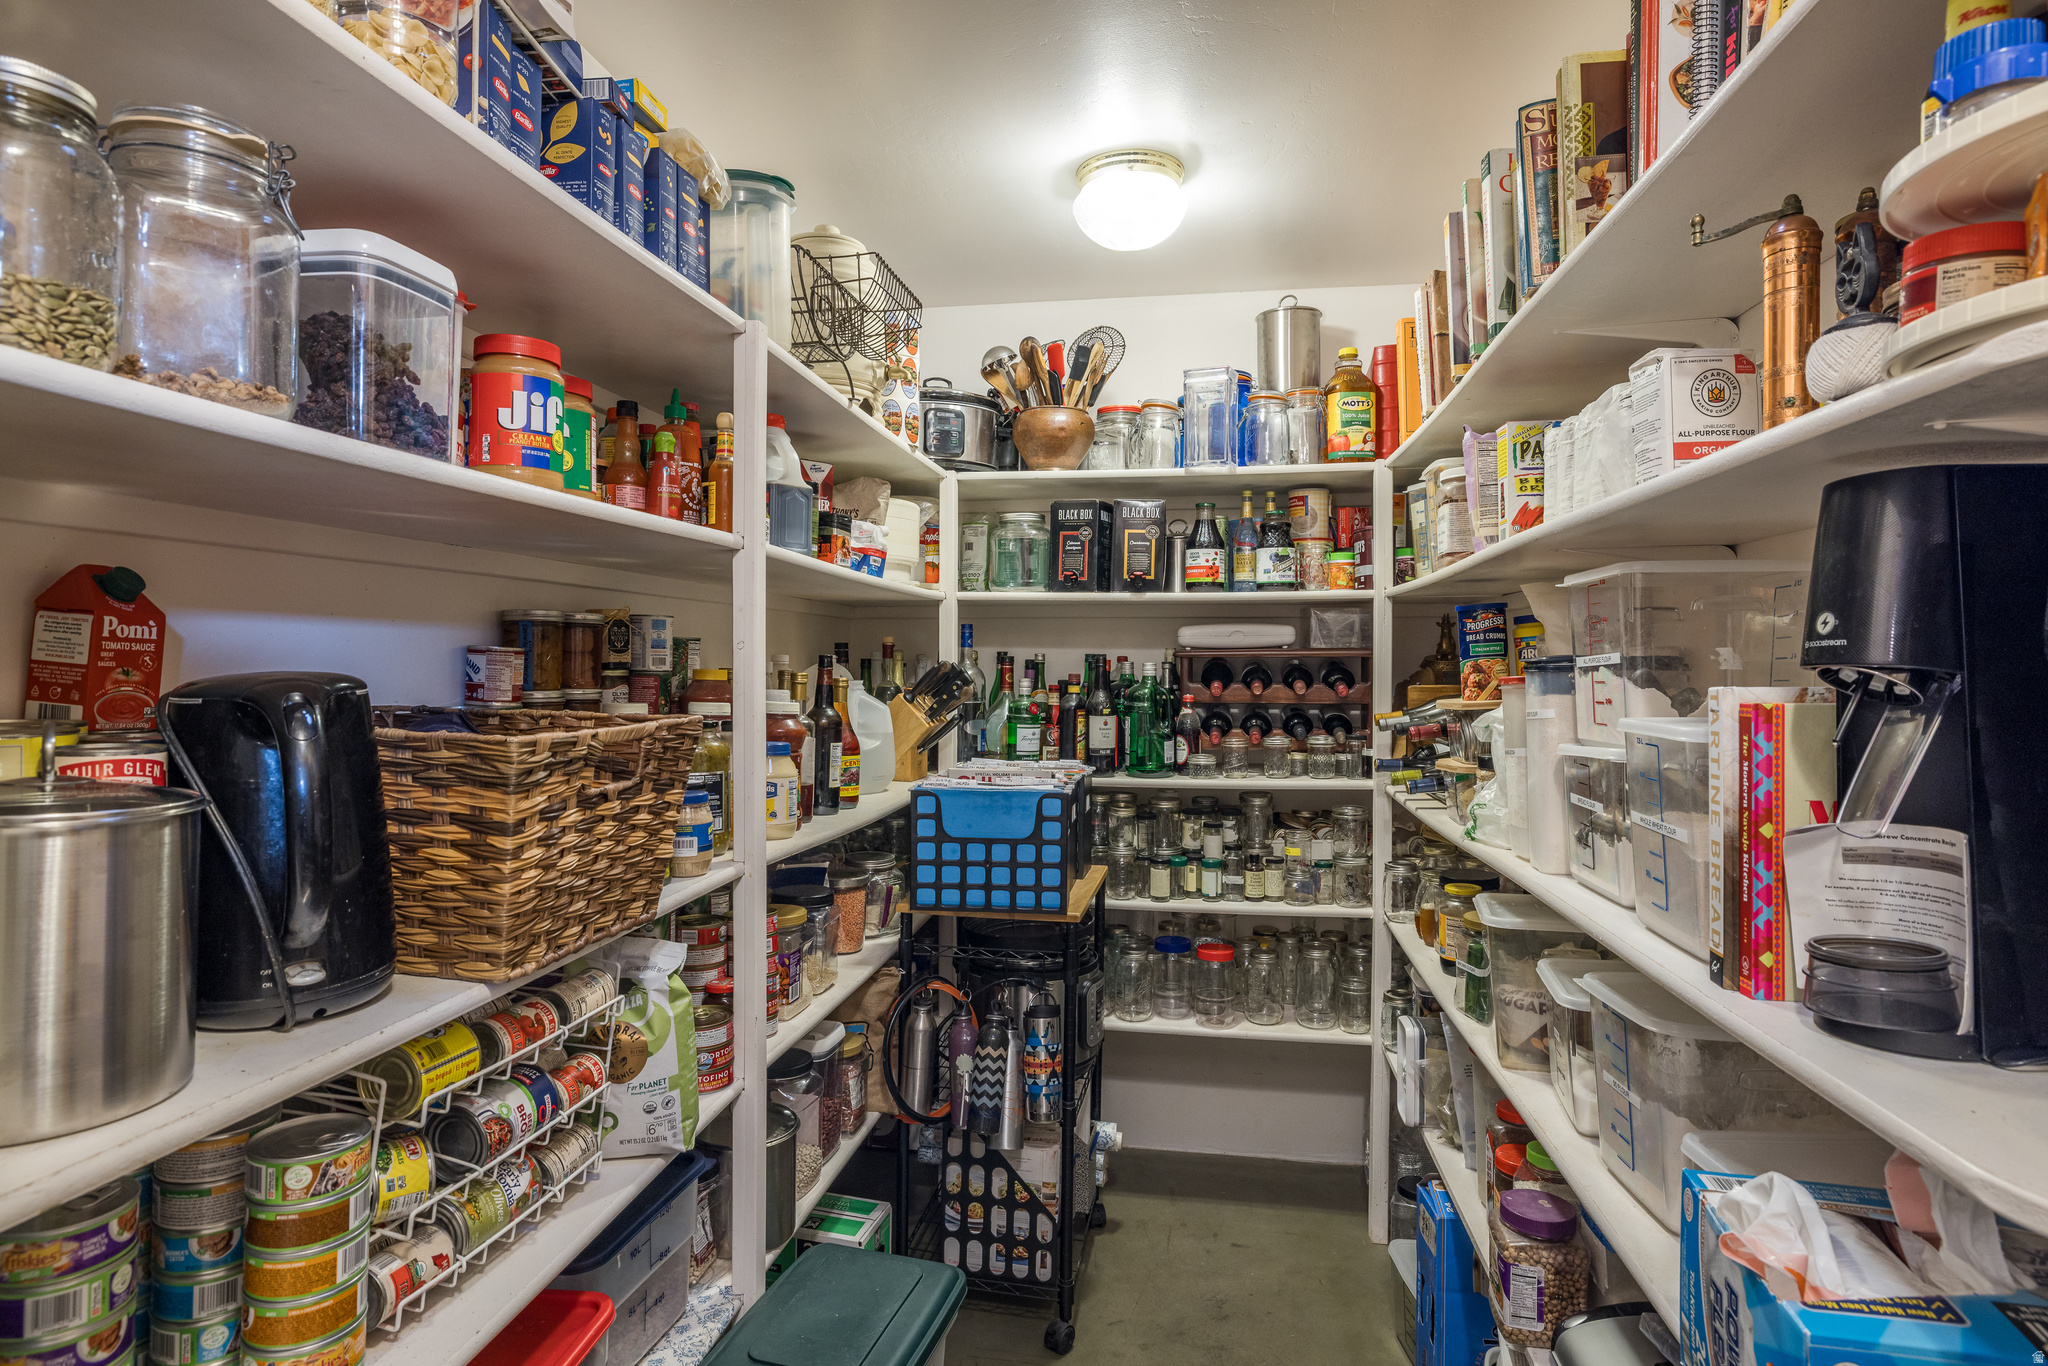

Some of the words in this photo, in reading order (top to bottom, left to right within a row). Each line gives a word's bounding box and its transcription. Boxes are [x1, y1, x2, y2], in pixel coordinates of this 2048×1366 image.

[1725, 5, 1739, 29] for
[494, 79, 510, 100] Barilla
[514, 111, 533, 131] Barilla
[599, 164, 612, 177] Barilla
[629, 185, 642, 200] Barilla
[664, 208, 676, 219] Barilla
[683, 223, 697, 237] Barilla
[1942, 264, 1982, 275] Nutrition
[1942, 273, 1966, 281] Facts
[1694, 374, 1709, 392] KING
[1710, 372, 1738, 391] ARTHUR
[1341, 400, 1371, 408] MOTT'S
[1696, 399, 1714, 414] BAKING
[1715, 398, 1737, 414] COMPANY
[497, 390, 564, 434] Jif
[512, 432, 547, 443] CREAMY
[1677, 429, 1731, 438] ALL-PURPOSE
[532, 440, 551, 449] BUTTER
[1058, 508, 1080, 521] BLACK
[1080, 508, 1094, 520] BOX
[1122, 507, 1145, 518] BLACK
[1146, 507, 1160, 519] BOX
[102, 615, 157, 640] Pomì
[1466, 617, 1504, 631] PROGRESSO
[1465, 633, 1485, 642] BREAD
[1485, 632, 1506, 640] CRUMBS
[1809, 639, 1848, 648] sodastream
[102, 641, 130, 651] TOMATO
[131, 642, 156, 652] SAUCE
[97, 660, 116, 668] SAUCES
[1709, 691, 1721, 826] TARTINE
[66, 763, 114, 778] MUIR
[123, 762, 161, 778] GLEN
[1639, 816, 1652, 827] WHOLE
[1651, 819, 1665, 831] WHEAT
[1665, 825, 1677, 836] FLOUR
[1742, 809, 1750, 852] Navajo
[1900, 834, 1941, 844] Concentrate
[1941, 838, 1957, 848] Recipe
[1710, 839, 1722, 949] BREAD
[500, 1015, 520, 1039] TOMATO
[426, 1077, 435, 1085] The
[435, 1067, 453, 1081] Original
[461, 1055, 477, 1069] Original
[626, 1082, 638, 1093] For
[638, 1077, 667, 1090] PLANET
[498, 1160, 521, 1188] Early
